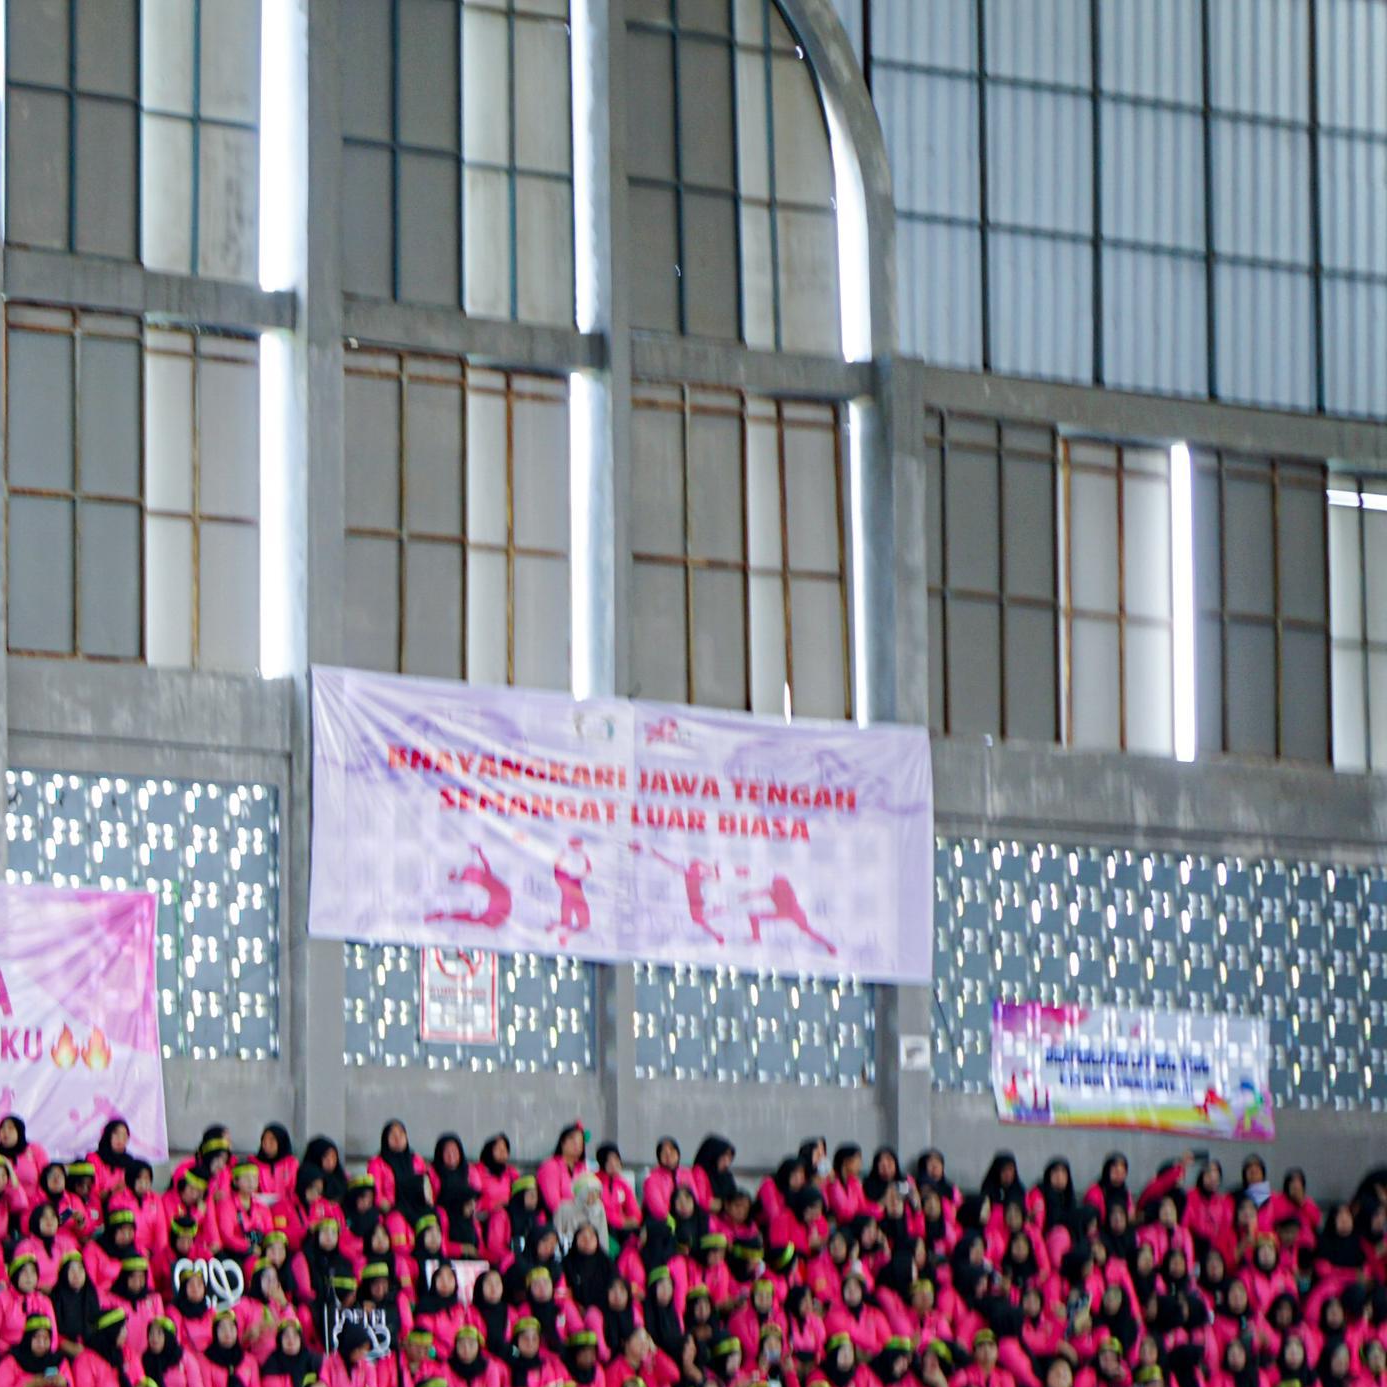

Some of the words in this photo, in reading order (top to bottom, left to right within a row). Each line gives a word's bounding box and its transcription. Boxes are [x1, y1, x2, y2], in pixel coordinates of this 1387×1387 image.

[637, 769, 720, 799] JAWA
[731, 779, 857, 813] TENGAH
[630, 803, 707, 832] LUAR
[717, 814, 811, 843] BIASA
